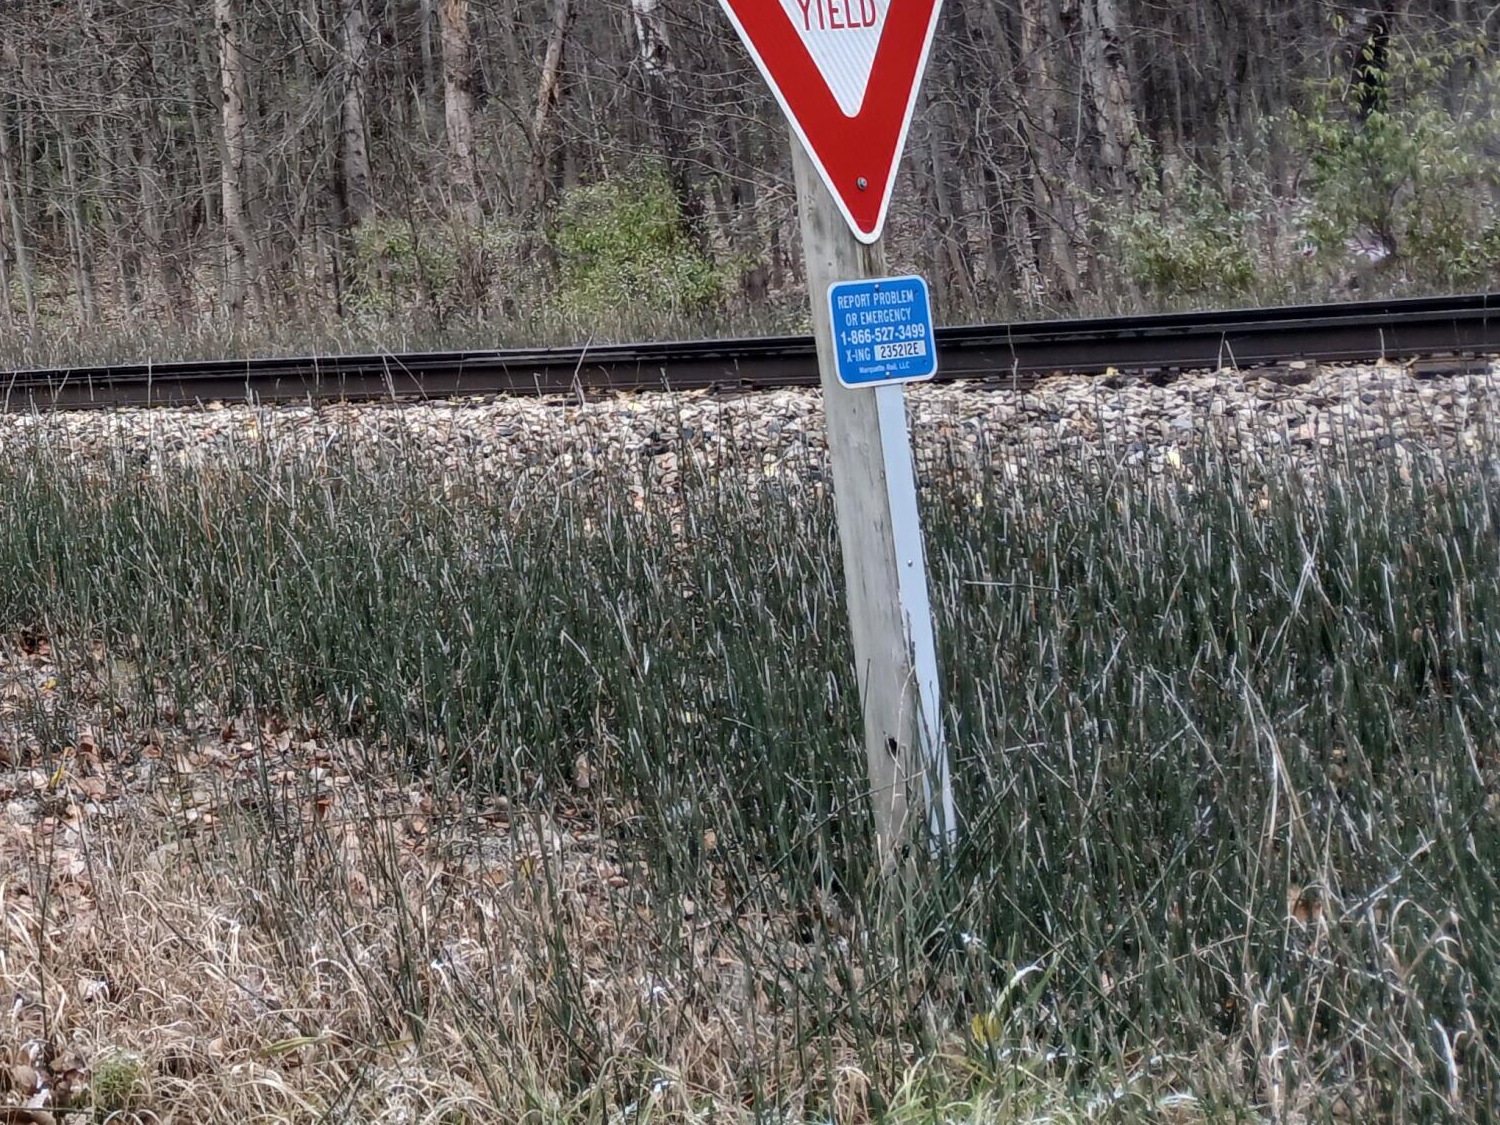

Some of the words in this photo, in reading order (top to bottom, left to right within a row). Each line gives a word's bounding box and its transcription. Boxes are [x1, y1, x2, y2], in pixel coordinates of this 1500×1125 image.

[837, 293, 870, 309] REPORT
[874, 290, 914, 305] PROBLEM
[845, 313, 859, 327] OR
[860, 307, 911, 325] EMERGENCY
[840, 324, 925, 345] 1-866-527-3499
[845, 347, 871, 363] X-ING
[880, 342, 919, 359] 235212E
[899, 361, 910, 370] LLC
